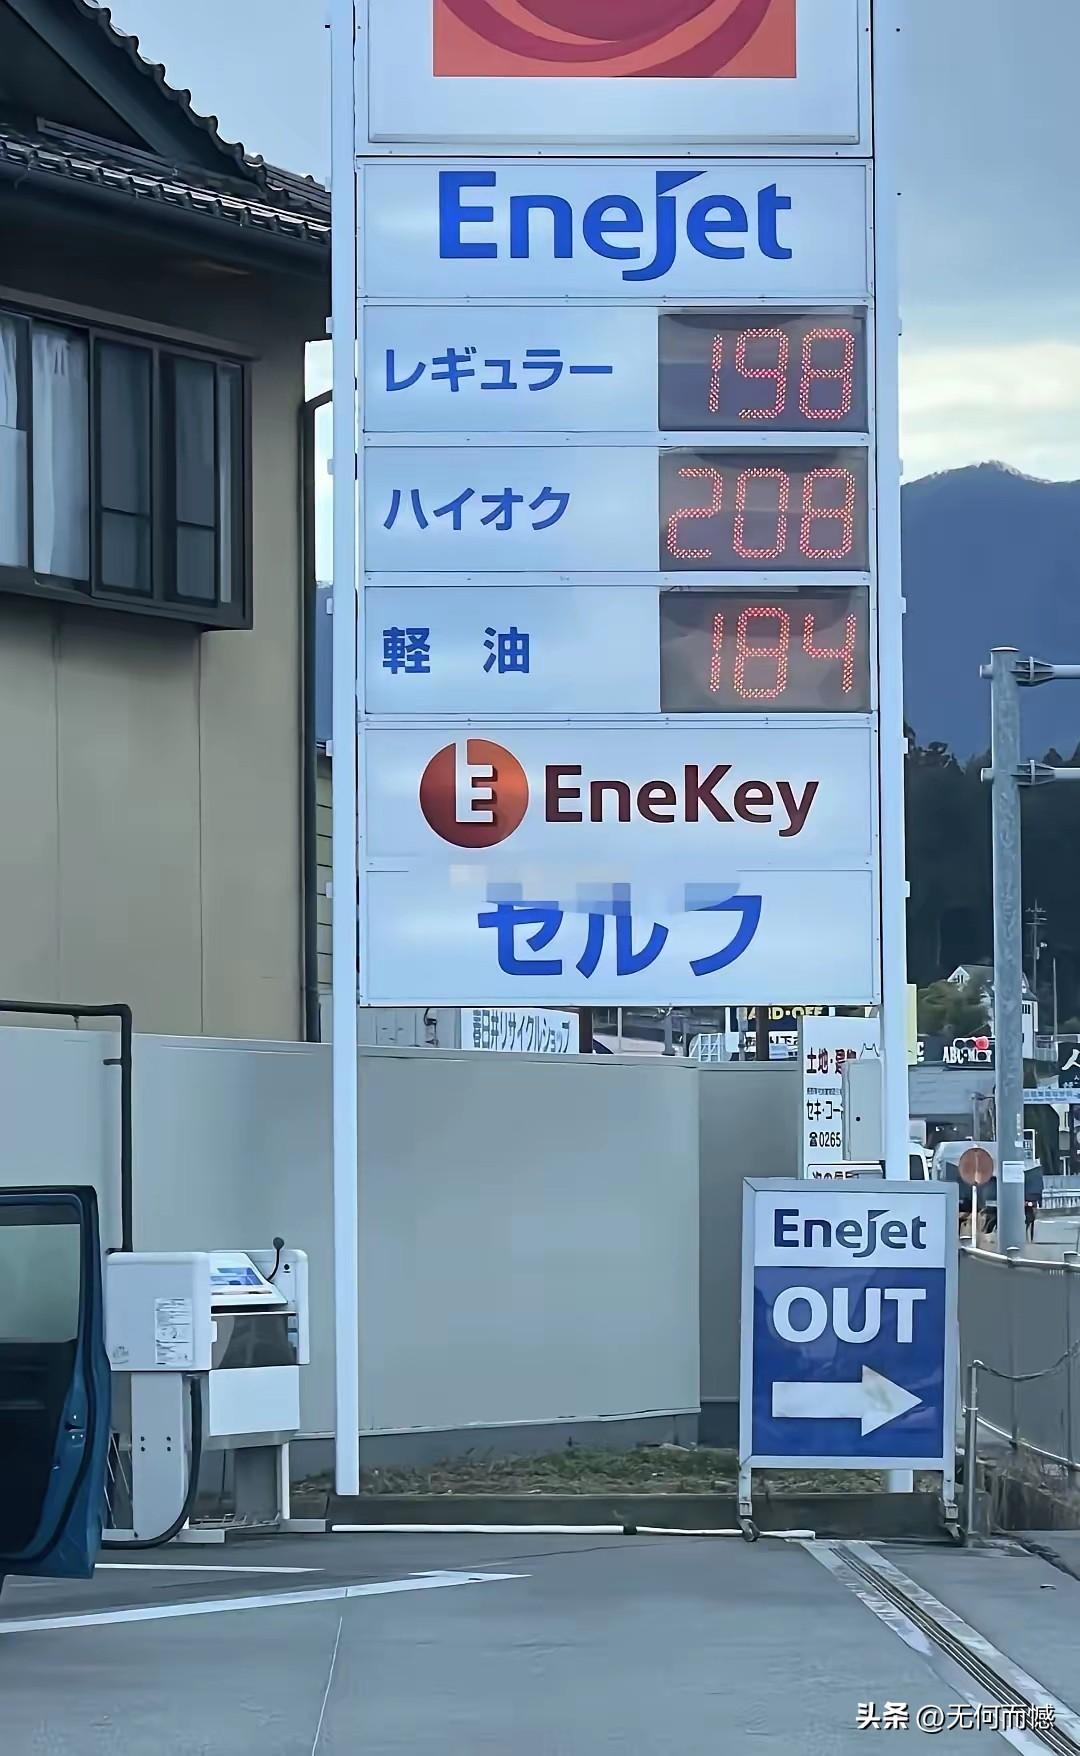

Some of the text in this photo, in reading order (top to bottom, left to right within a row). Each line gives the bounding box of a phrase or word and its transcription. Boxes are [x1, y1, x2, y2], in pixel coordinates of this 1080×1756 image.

[385, 346, 614, 392] レギュラー
[708, 328, 856, 419] 198
[383, 486, 571, 532] ハイオク
[665, 468, 855, 560] 208
[709, 607, 857, 699] 184
[545, 764, 820, 838] EneKey
[477, 885, 763, 980] セルフ
[772, 1286, 927, 1344] OUT
